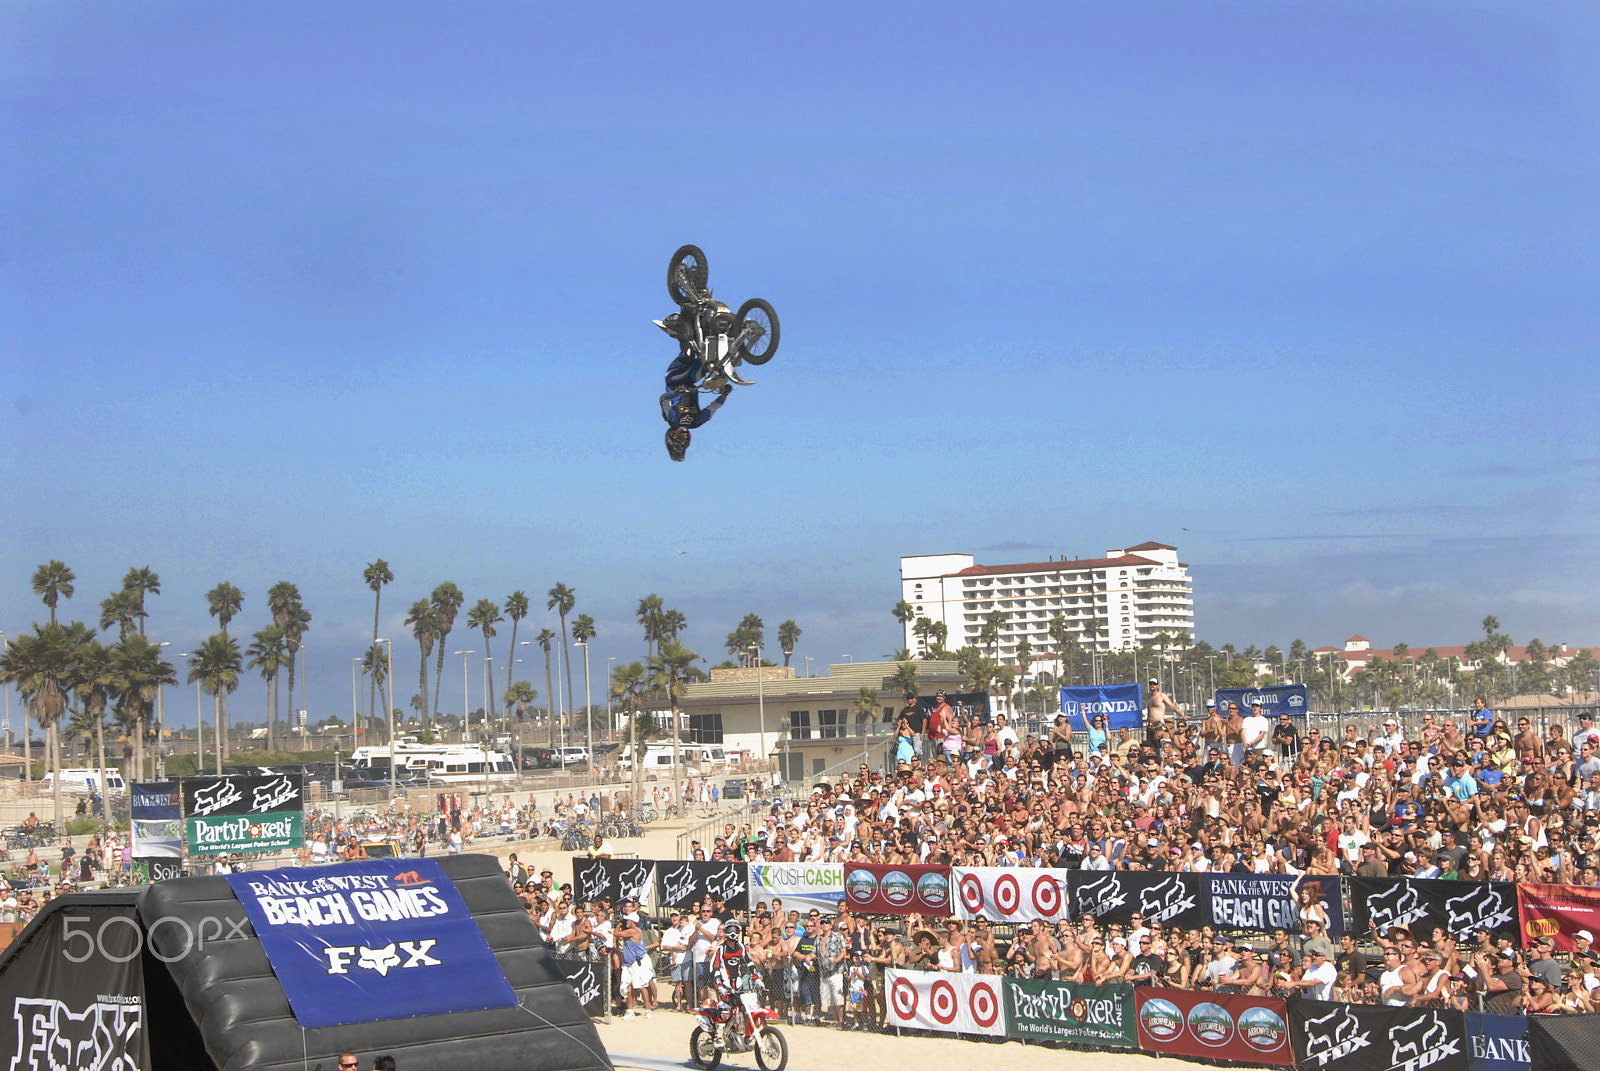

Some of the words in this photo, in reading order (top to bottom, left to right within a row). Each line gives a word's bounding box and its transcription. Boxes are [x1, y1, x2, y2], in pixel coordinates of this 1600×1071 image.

[1079, 700, 1139, 714] HONDA
[248, 881, 314, 896] BANK
[328, 874, 389, 890] WEST
[721, 880, 746, 901] OX
[1211, 879, 1248, 895] BANK
[257, 892, 355, 926] BEACH
[350, 886, 449, 922] GAMES
[1212, 895, 1265, 929] BEACH
[1529, 920, 1556, 934] TONIK
[579, 984, 601, 1007] OX
[1017, 1022, 1028, 1032] The
[1029, 1023, 1052, 1034] World's
[1054, 1025, 1078, 1037] Largest
[1079, 1028, 1097, 1038] Poker
[1099, 1029, 1122, 1039] School
[1148, 1016, 1176, 1030] ARROWHEAD
[1197, 1021, 1226, 1035] ARROWHEAD
[1247, 1026, 1278, 1040] ARROWHEAD
[1471, 1034, 1532, 1063] BANK
